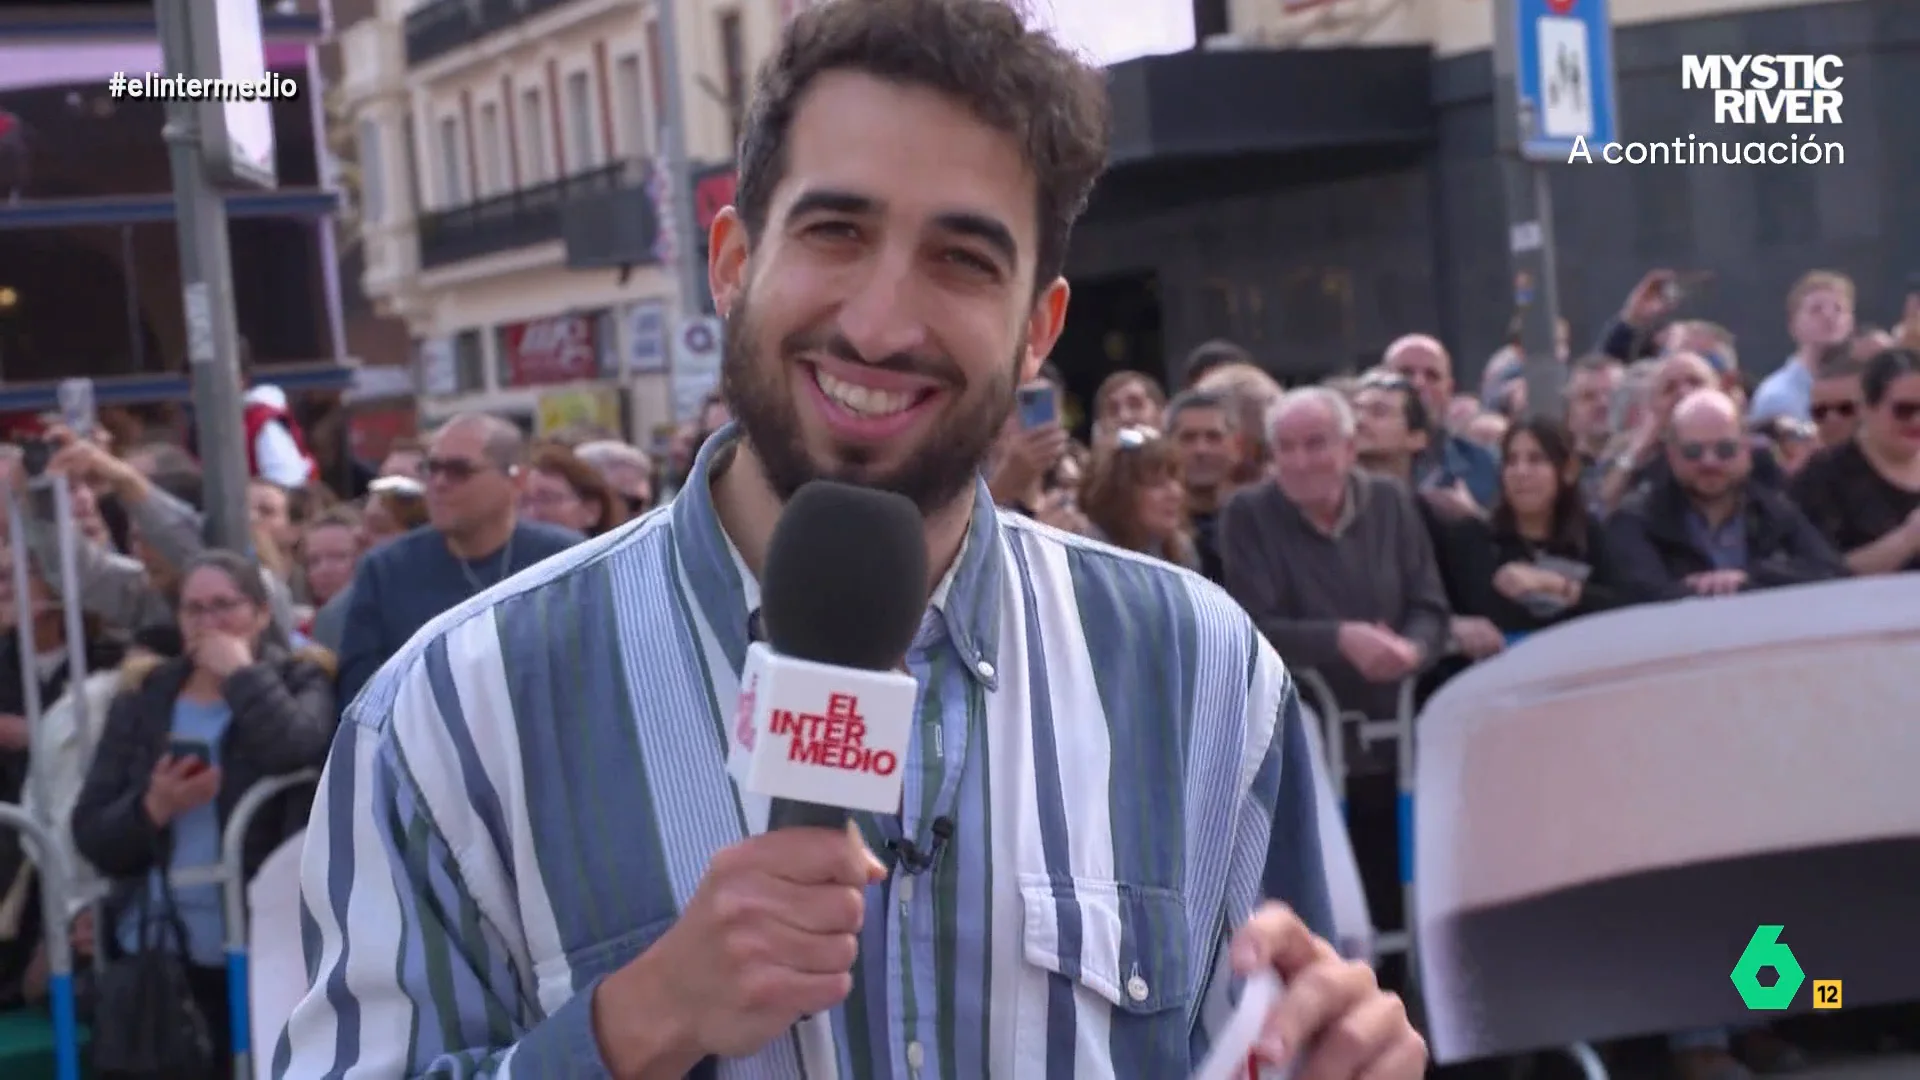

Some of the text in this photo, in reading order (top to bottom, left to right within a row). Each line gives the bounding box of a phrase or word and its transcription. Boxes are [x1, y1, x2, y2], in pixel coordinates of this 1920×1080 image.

[827, 692, 864, 721] EL
[769, 708, 867, 747] INTER
[788, 736, 898, 777] MEDIO
